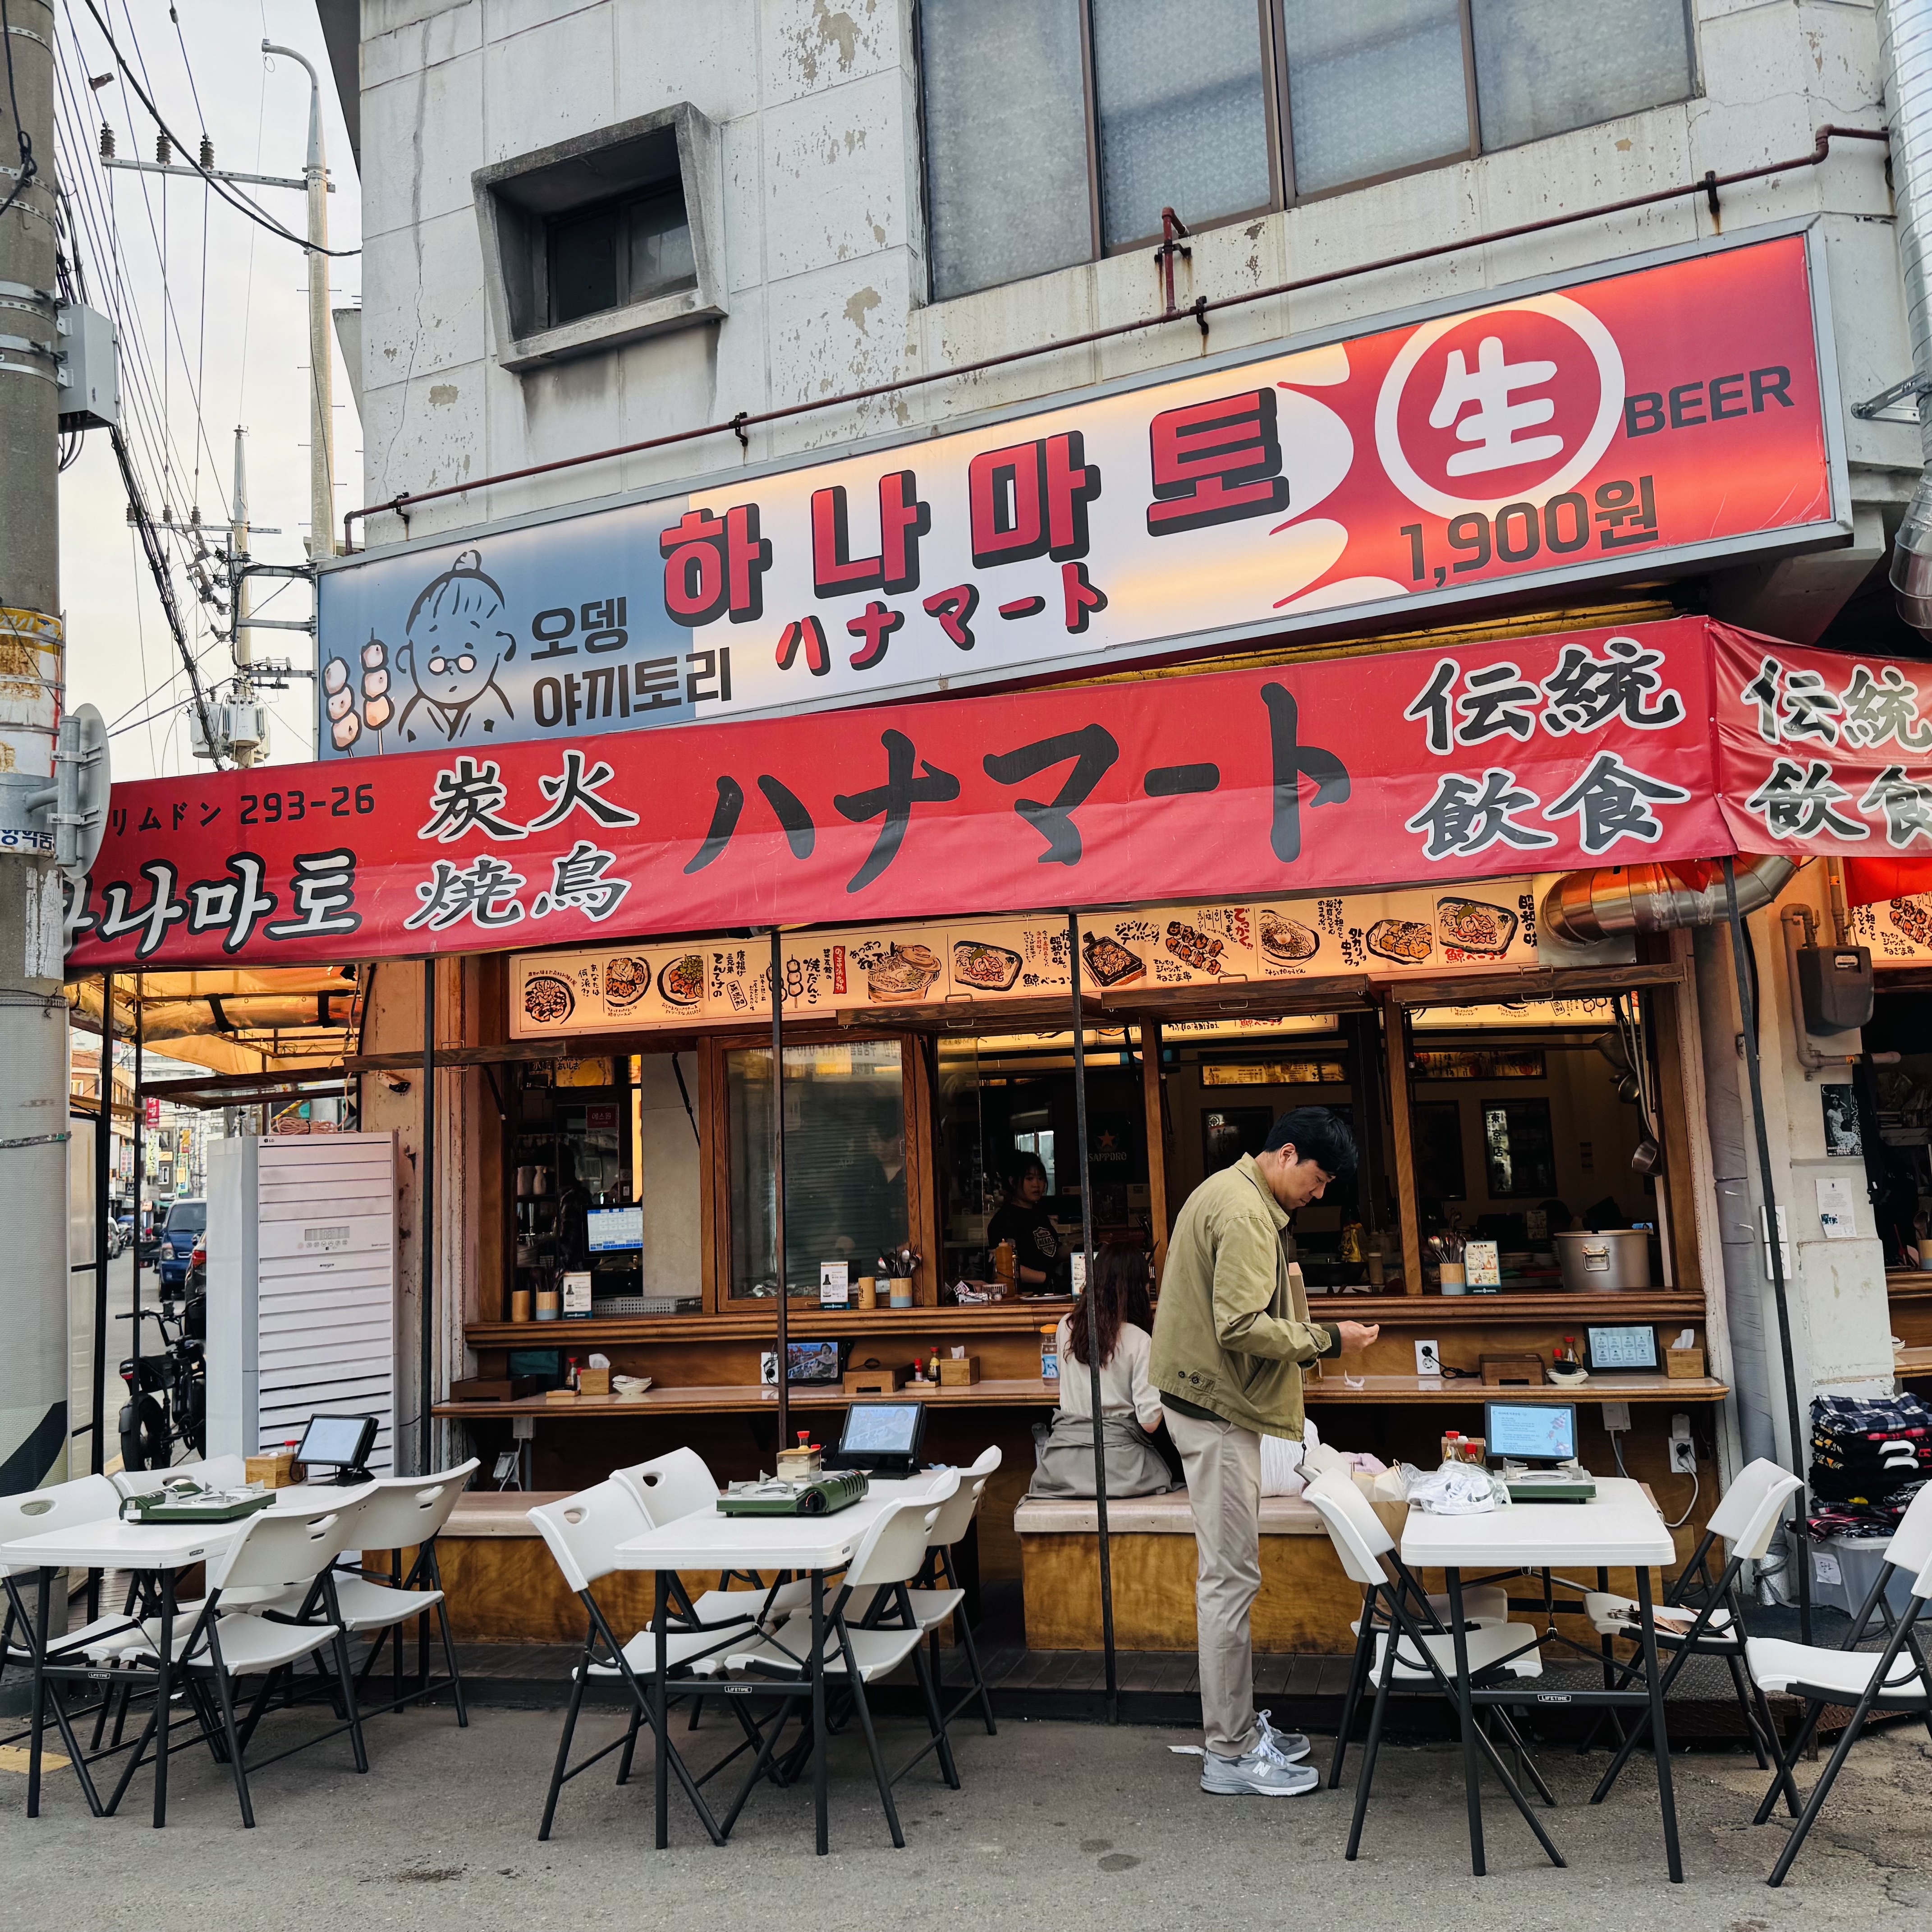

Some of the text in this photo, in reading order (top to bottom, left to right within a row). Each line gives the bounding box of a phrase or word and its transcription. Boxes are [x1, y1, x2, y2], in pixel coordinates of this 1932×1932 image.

[1429, 336, 1564, 477] 生
[1624, 365, 1794, 439] BEER
[660, 387, 1290, 627] 하나마토
[1401, 475, 1659, 587] 1,900원
[530, 597, 629, 661] 오뎅
[776, 561, 1107, 676] ハナマート
[533, 647, 732, 727] 야끼토리
[1404, 637, 1685, 755] 伝統
[1740, 654, 1932, 754] 伝統
[113, 783, 374, 837] リムドン 293-26
[418, 749, 640, 843] 炭火
[683, 682, 1351, 893] ハナマート
[1406, 752, 1690, 860] 飲食
[404, 840, 632, 931] 焼鳥
[591, 964, 601, 996] あなたは
[736, 950, 747, 977] 唐揚げ
[803, 958, 821, 1004] 焼だんご
[1156, 971, 1192, 982] ねぎま串
[1088, 1152, 1127, 1162] SAPPORO
